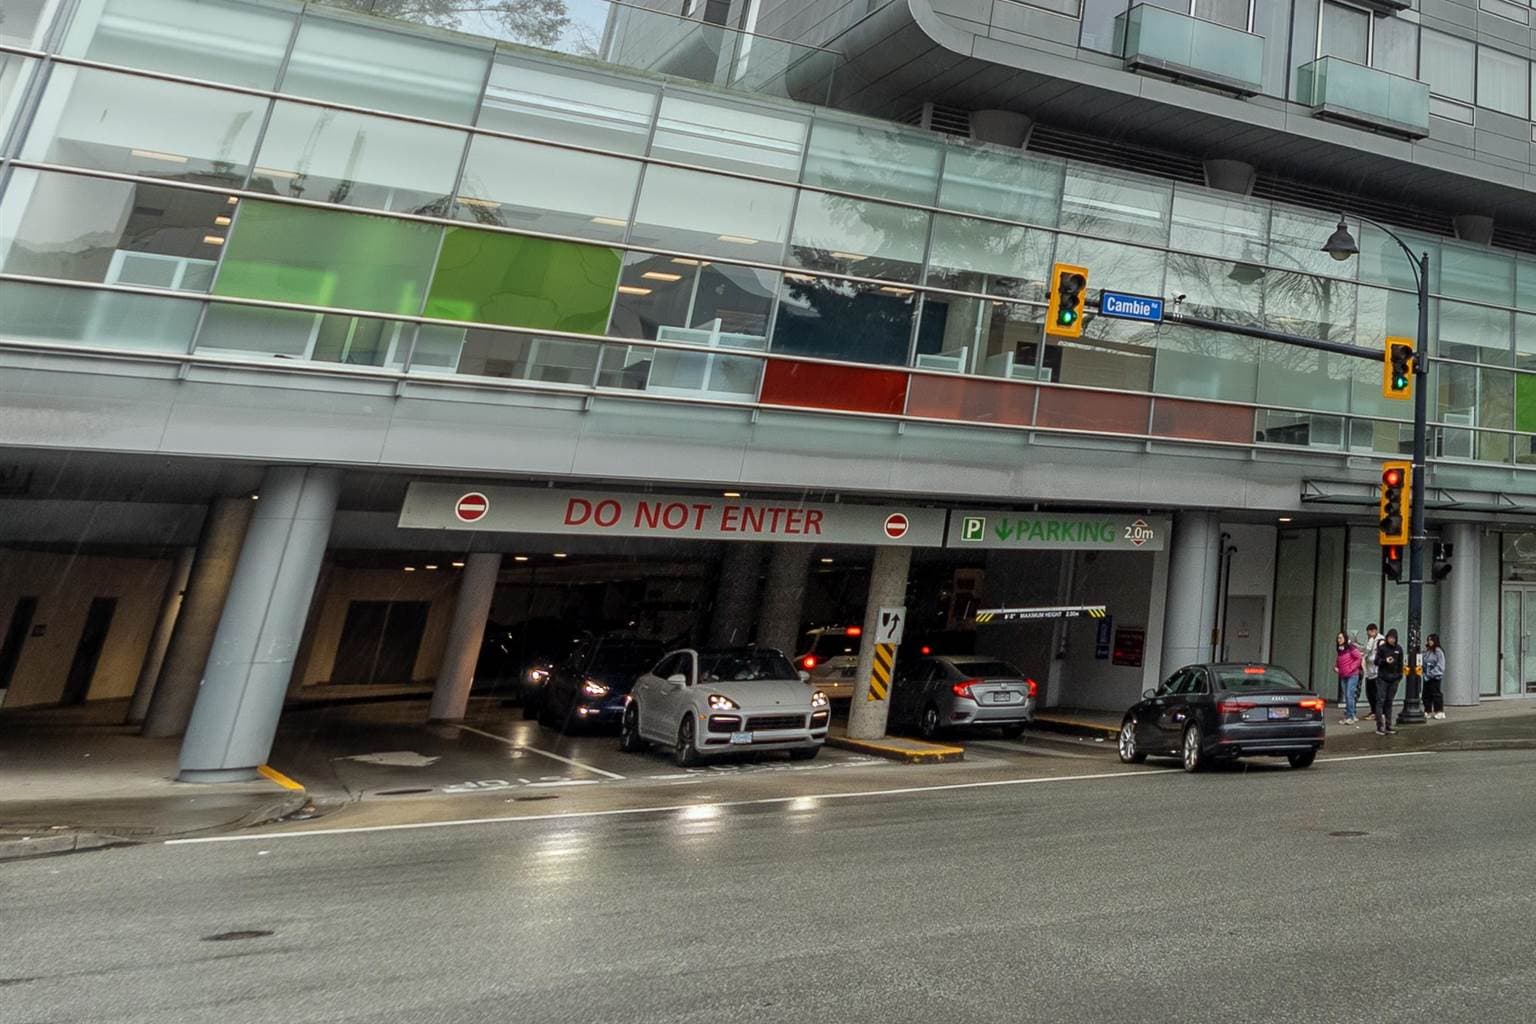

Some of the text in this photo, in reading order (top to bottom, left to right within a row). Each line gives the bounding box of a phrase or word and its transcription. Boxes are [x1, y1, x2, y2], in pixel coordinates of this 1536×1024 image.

[1107, 297, 1150, 315] Cambie
[564, 498, 824, 535] DO NOT ENTER
[967, 520, 980, 538] P
[1016, 519, 1116, 542] PARKING
[1123, 526, 1154, 539] 2.0m
